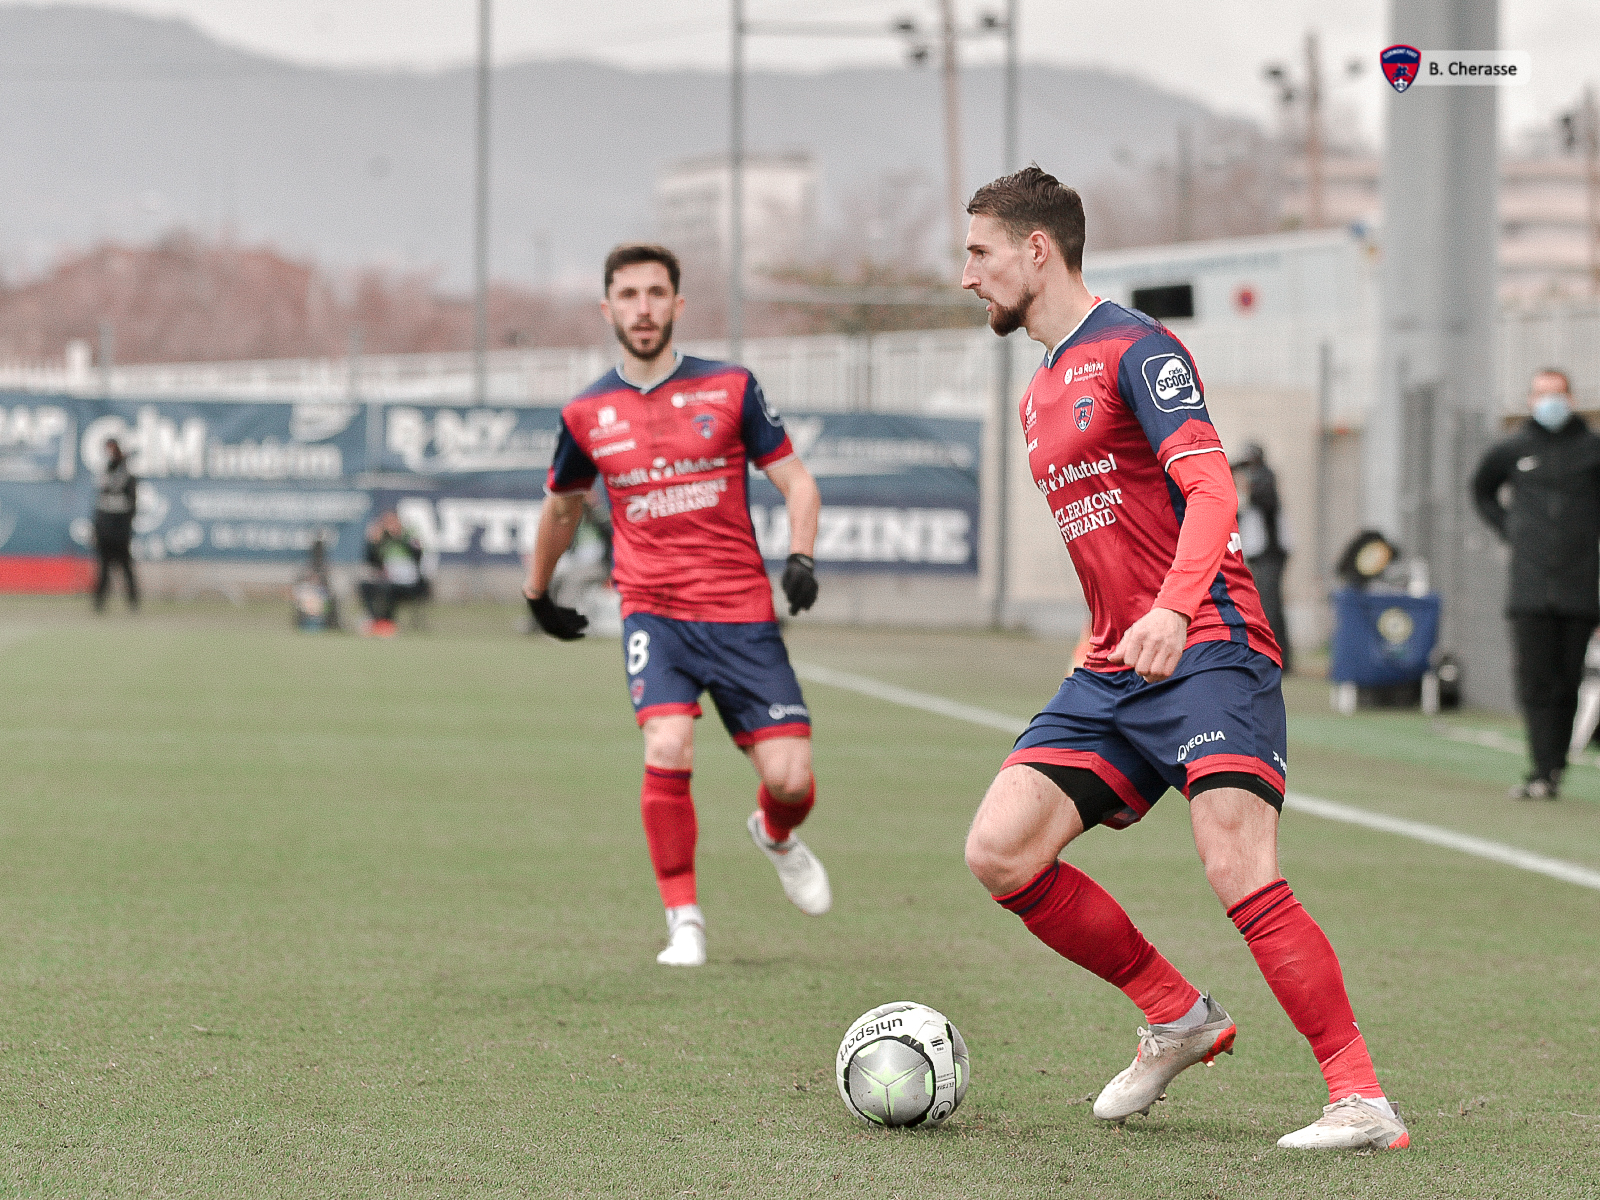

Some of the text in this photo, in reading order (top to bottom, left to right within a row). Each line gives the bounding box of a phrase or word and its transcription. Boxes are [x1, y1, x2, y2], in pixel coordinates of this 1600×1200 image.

[1157, 373, 1191, 392] SCOOP
[1061, 453, 1118, 484] Mutuel
[1054, 488, 1123, 527] CLERMONT
[1061, 508, 1118, 543] FERRAND
[627, 629, 650, 676] 8
[1186, 730, 1226, 753] VEOLIA
[839, 1017, 903, 1062] uhlsport
